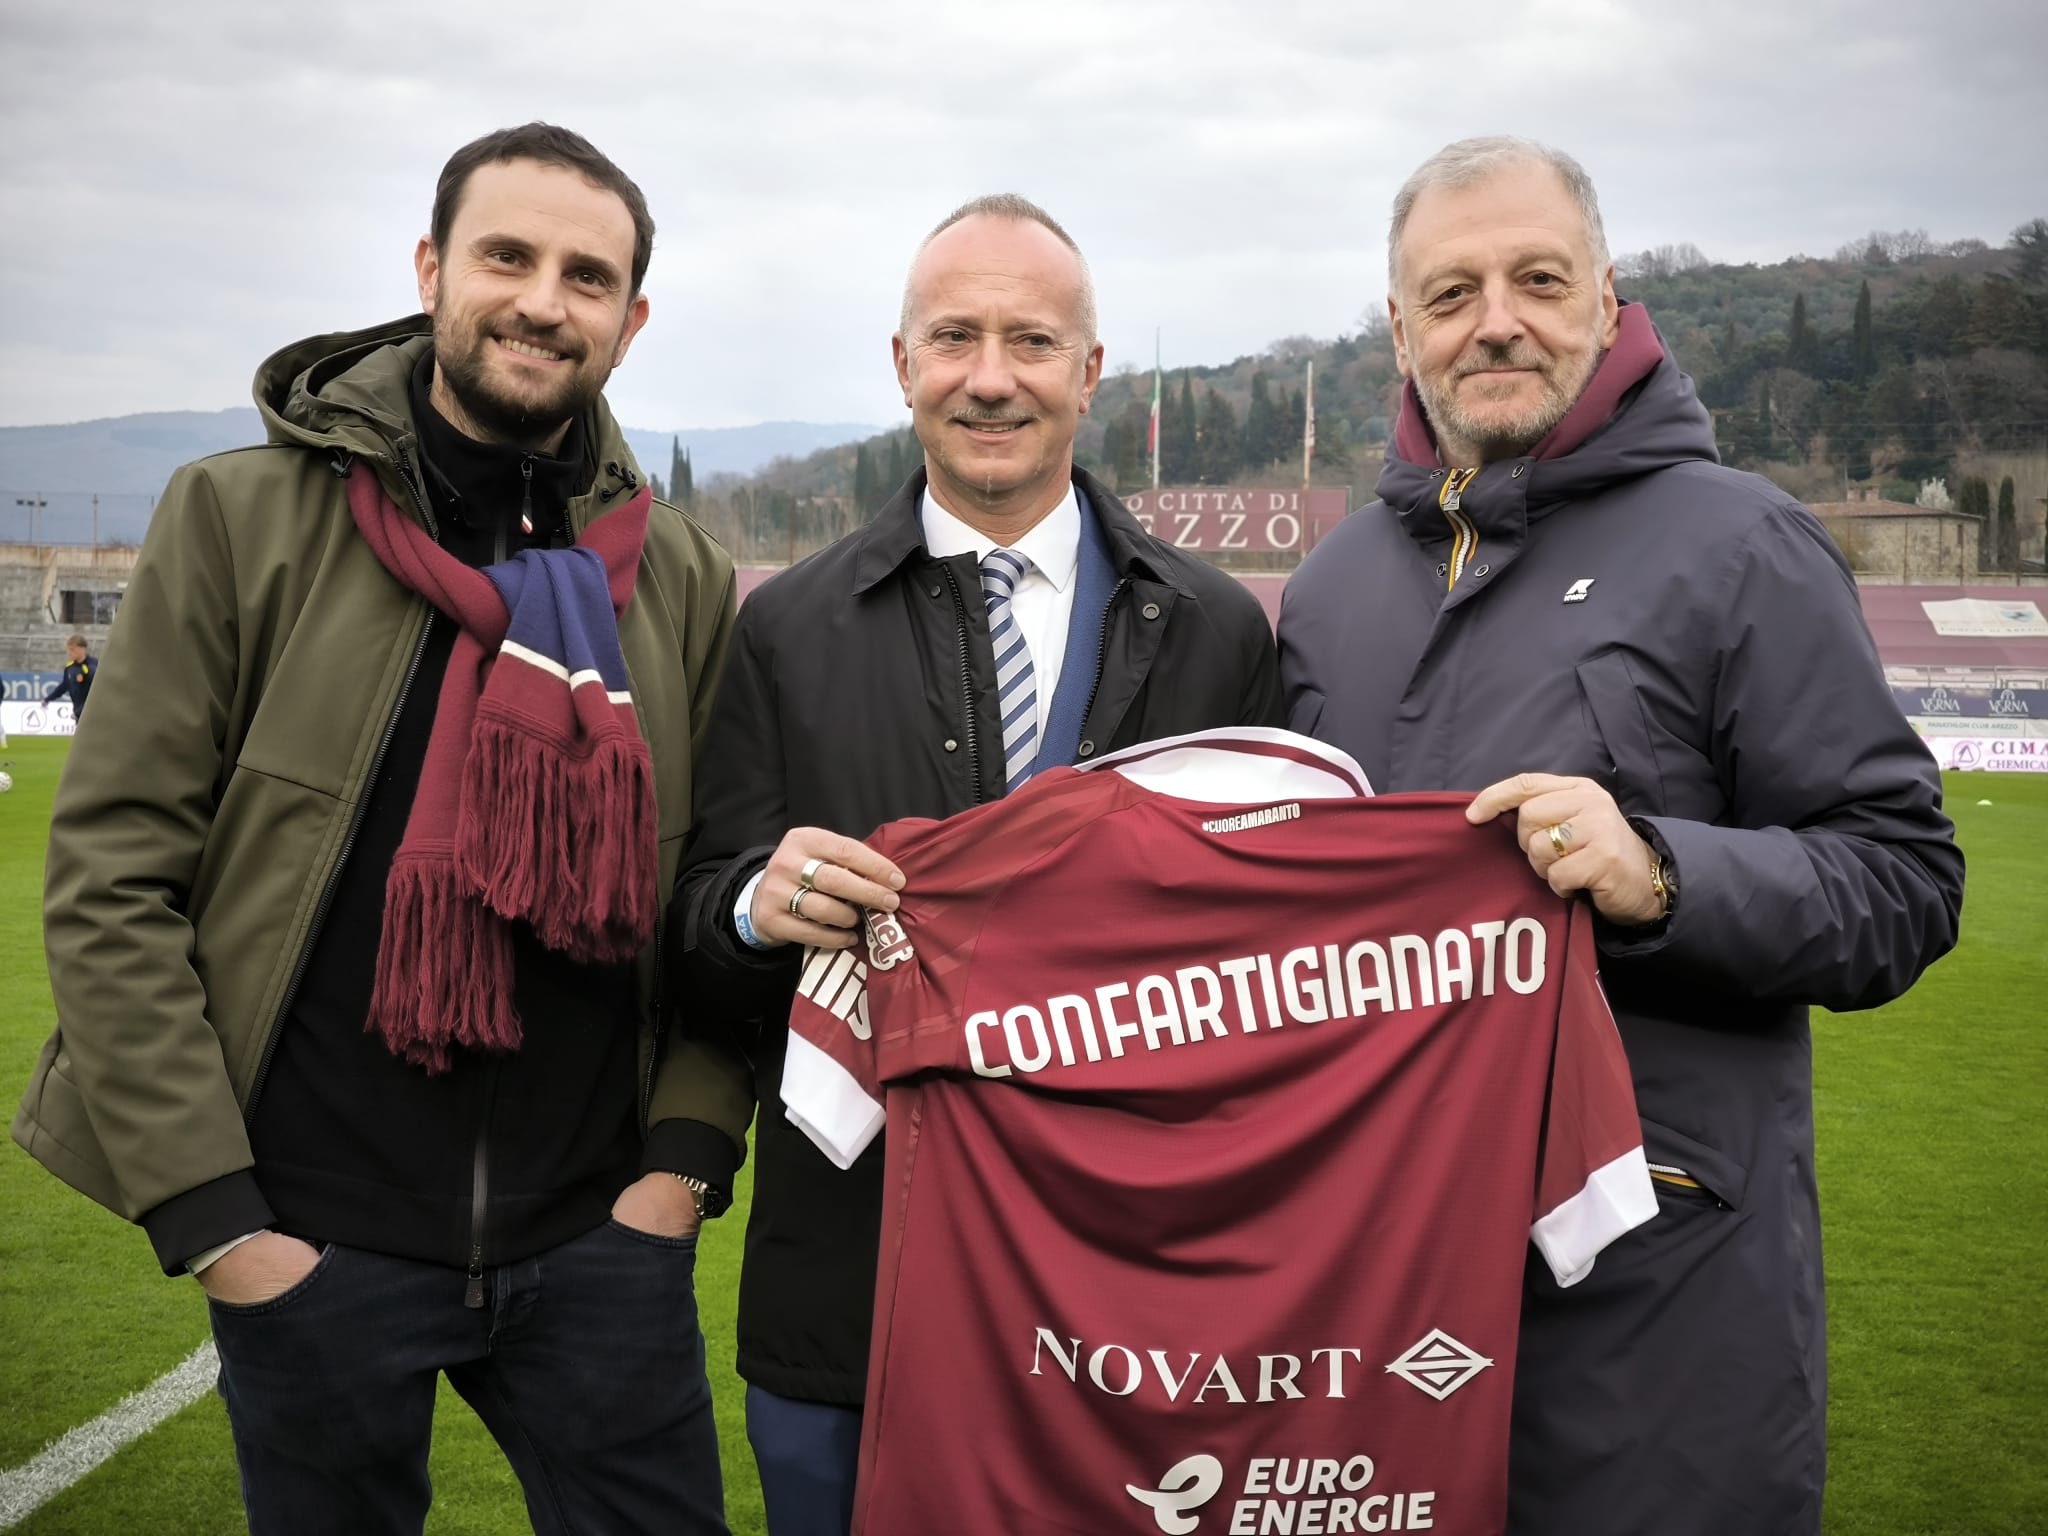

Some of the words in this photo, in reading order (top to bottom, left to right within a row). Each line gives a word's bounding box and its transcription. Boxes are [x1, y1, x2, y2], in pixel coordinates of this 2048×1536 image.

[1270, 493, 1298, 511] DI
[1991, 722, 2018, 730] AREZZO
[1987, 759, 2048, 770] CHEMICA
[964, 917, 1547, 1078] CONFARTIGIANATO
[1028, 1327, 1362, 1403] NOVART
[1243, 1454, 1375, 1496] EURO
[1228, 1491, 1436, 1536] ENERGIE
